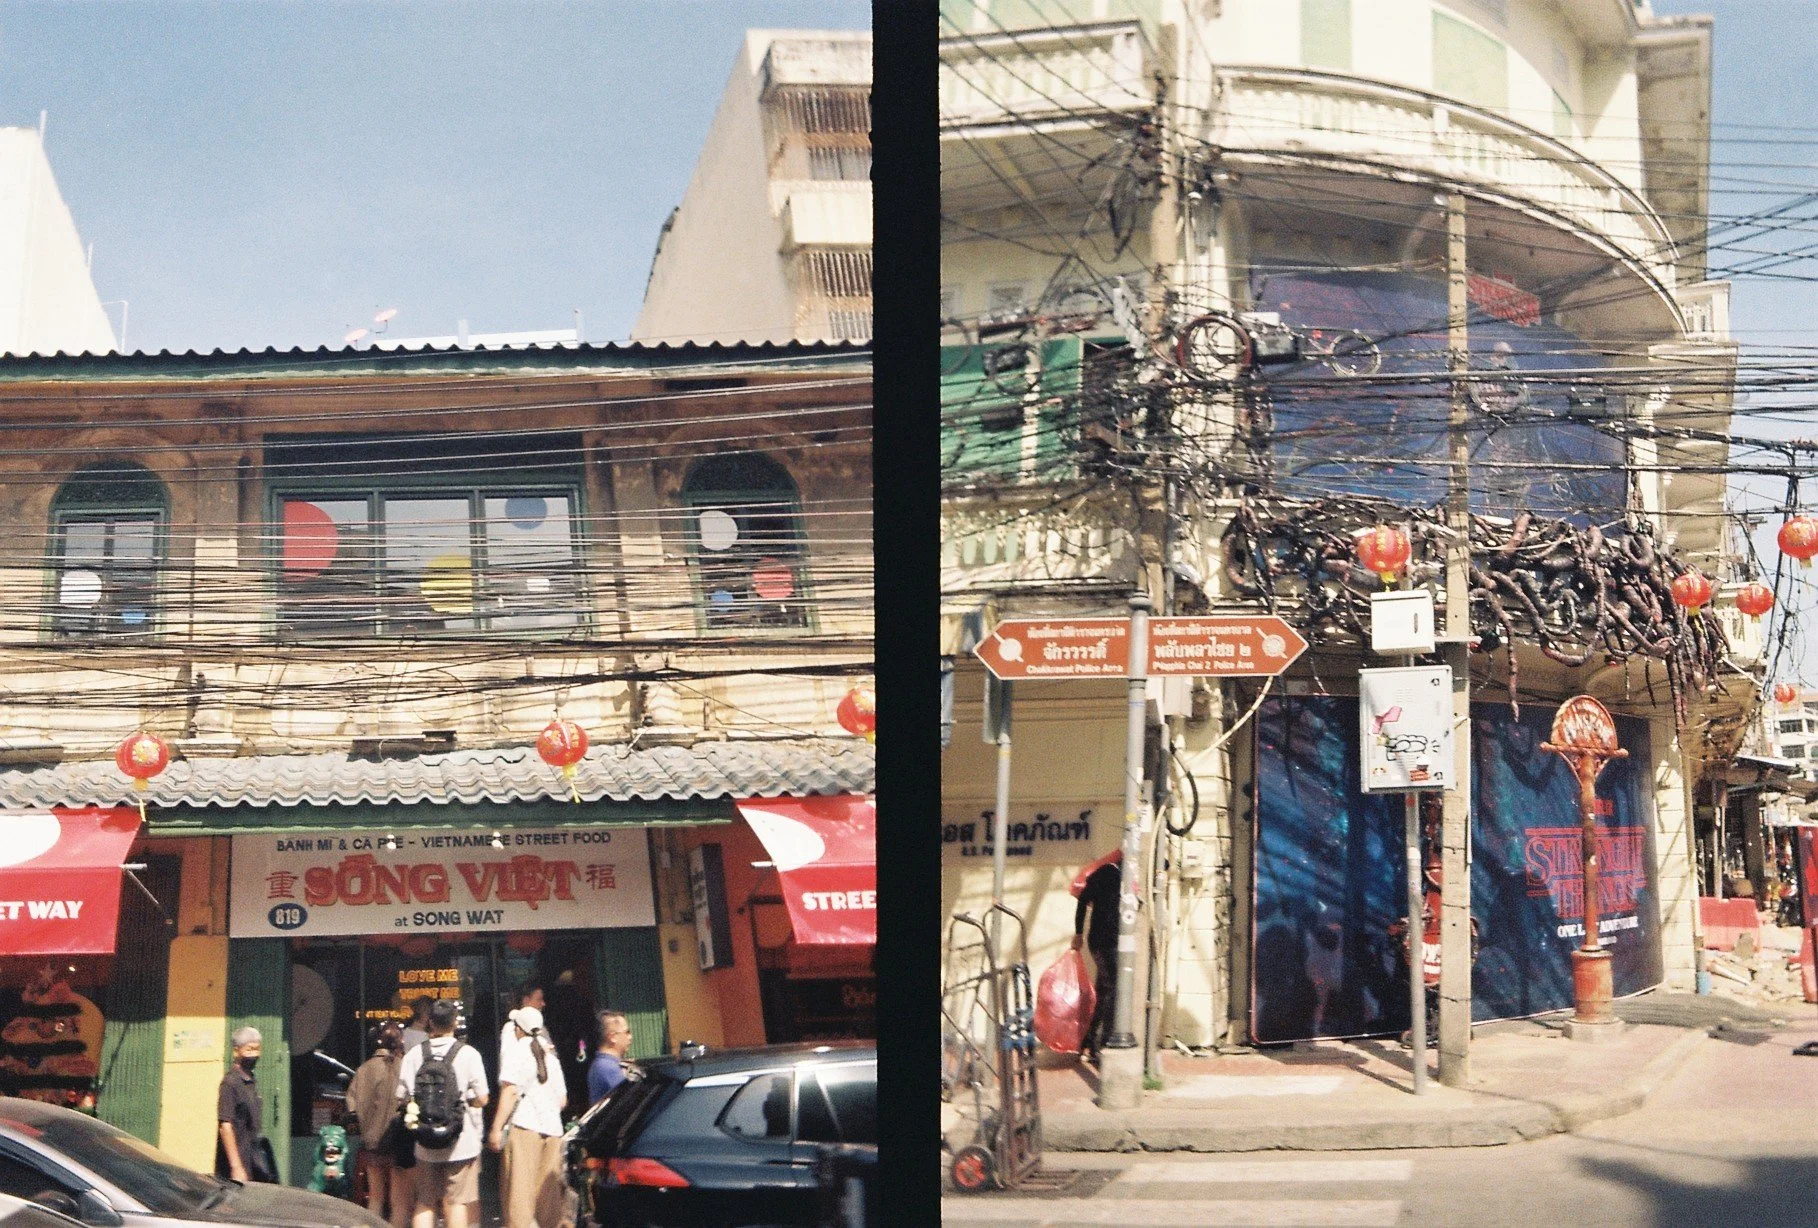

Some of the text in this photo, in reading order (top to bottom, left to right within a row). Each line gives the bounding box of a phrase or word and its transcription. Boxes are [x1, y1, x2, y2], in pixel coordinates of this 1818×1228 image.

[1075, 663, 1101, 673] Police
[1102, 663, 1123, 672] Area
[1213, 660, 1235, 669] Police
[1237, 660, 1254, 669] Area
[981, 809, 1091, 842] โคภัณฑ์
[422, 834, 510, 848] VIETNAMEE
[516, 833, 567, 845] STREET
[573, 832, 611, 844] FOOD
[28, 901, 83, 919] WAY
[275, 909, 300, 925] 819
[395, 910, 504, 926] at SONG WAT
[1557, 925, 1578, 938] ONE
[399, 969, 459, 983] LOVE ME
